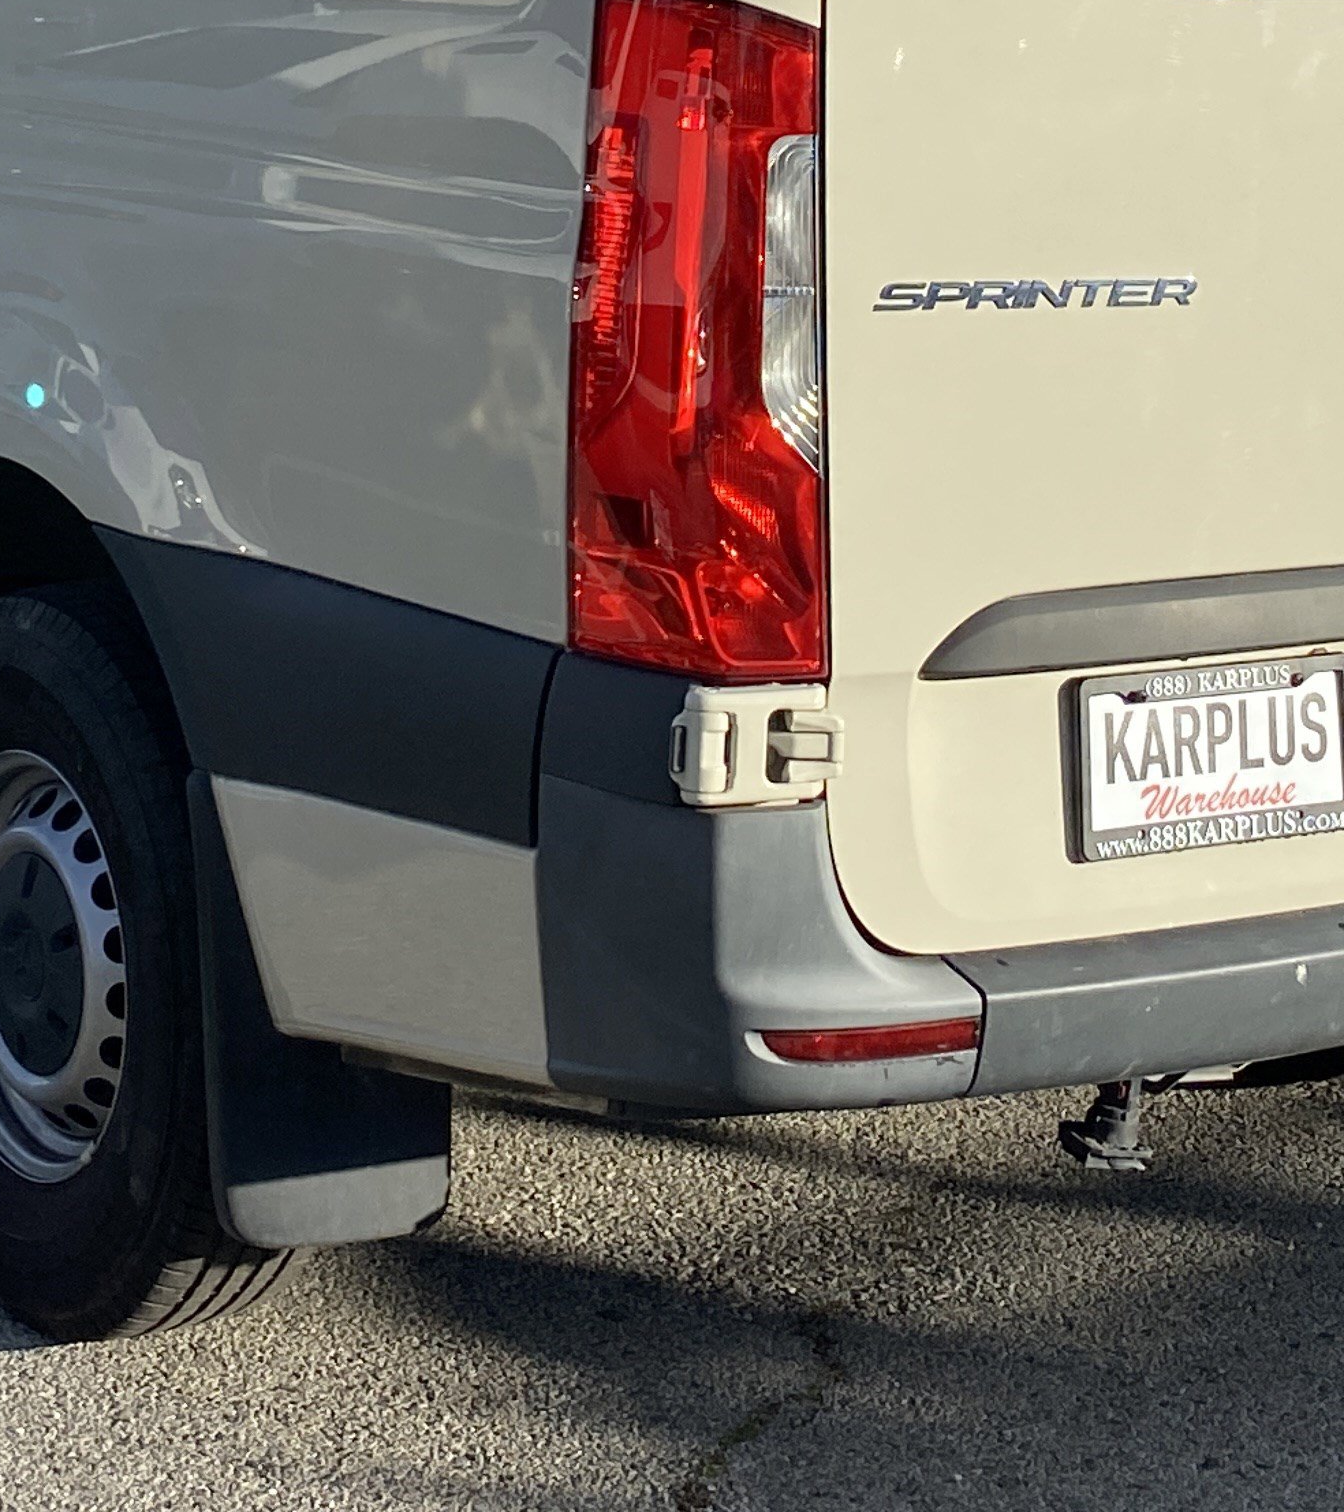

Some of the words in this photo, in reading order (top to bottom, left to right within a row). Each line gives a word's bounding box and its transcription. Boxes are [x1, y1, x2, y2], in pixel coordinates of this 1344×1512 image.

[872, 278, 1198, 312] SPRINTER
[1144, 674, 1192, 698] (888)
[1197, 664, 1291, 693] KARPLUS
[1104, 691, 1329, 785] KARPLUS
[1139, 772, 1297, 821] Warehouse
